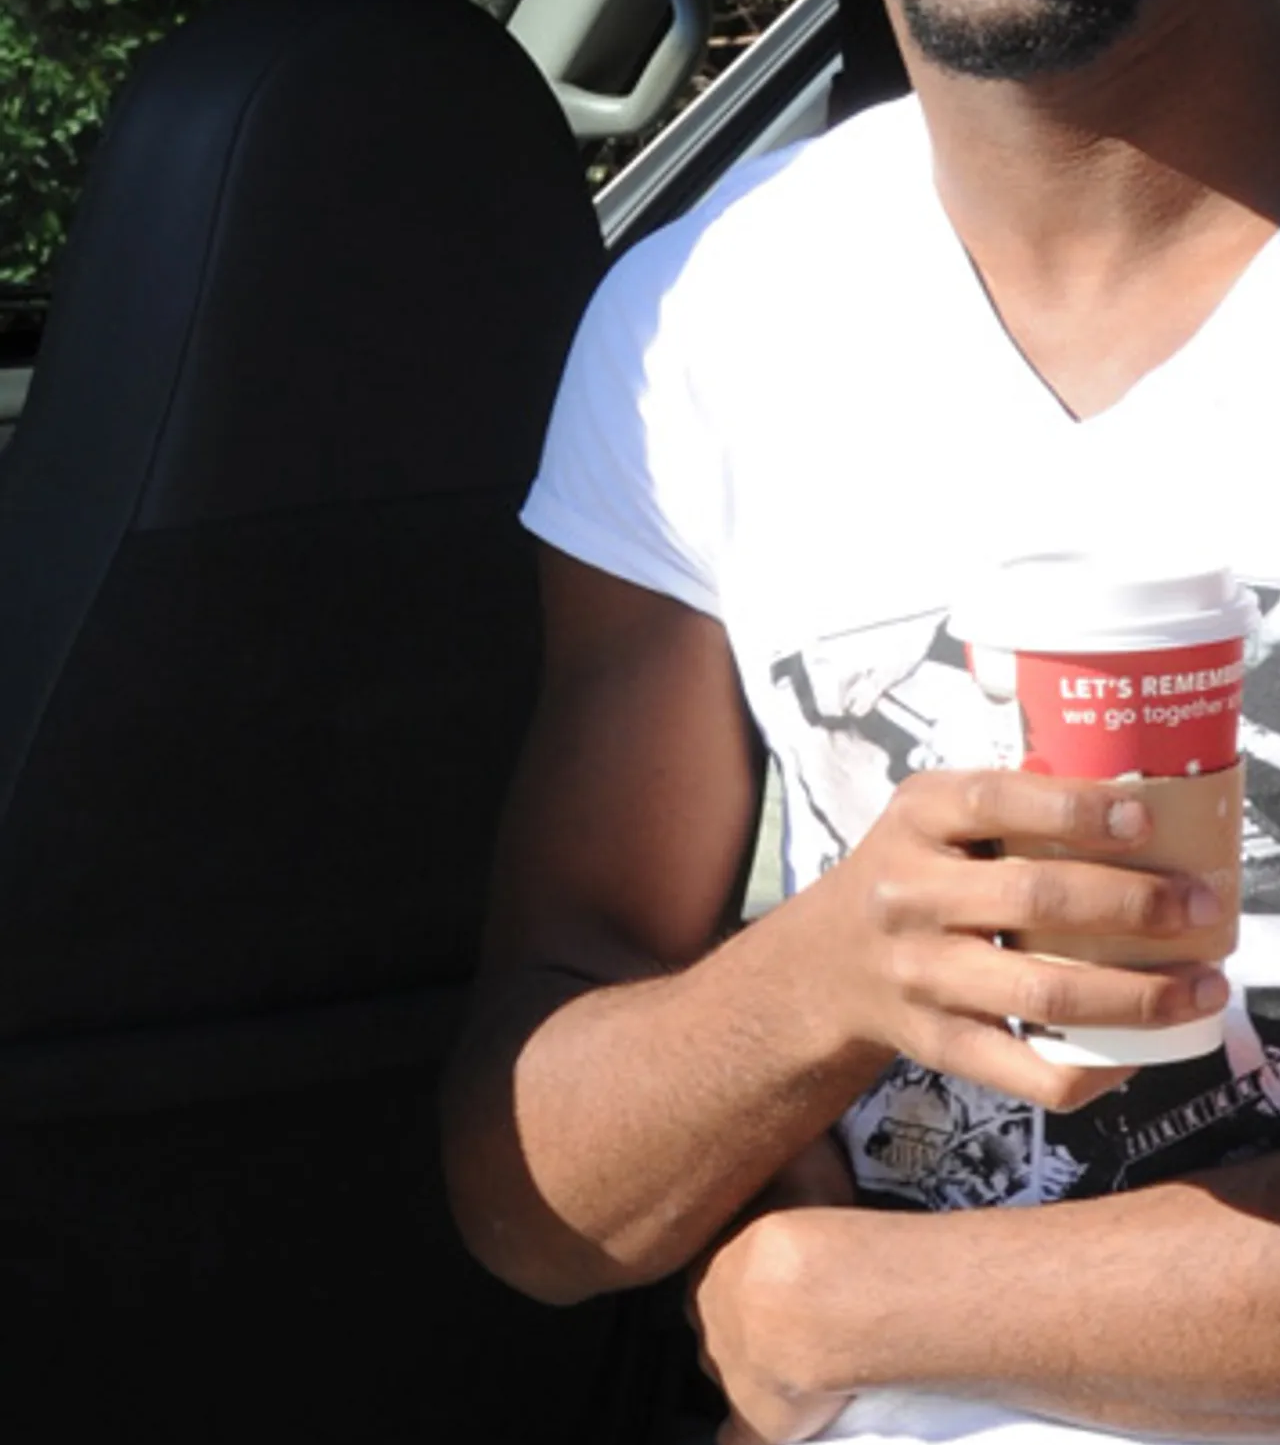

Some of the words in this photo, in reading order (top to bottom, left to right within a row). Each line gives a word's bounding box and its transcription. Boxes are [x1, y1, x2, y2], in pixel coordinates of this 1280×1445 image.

[1060, 675, 1133, 700] LET'S
[1062, 709, 1096, 726] we
[1105, 709, 1137, 731] go
[1143, 698, 1222, 728] together
